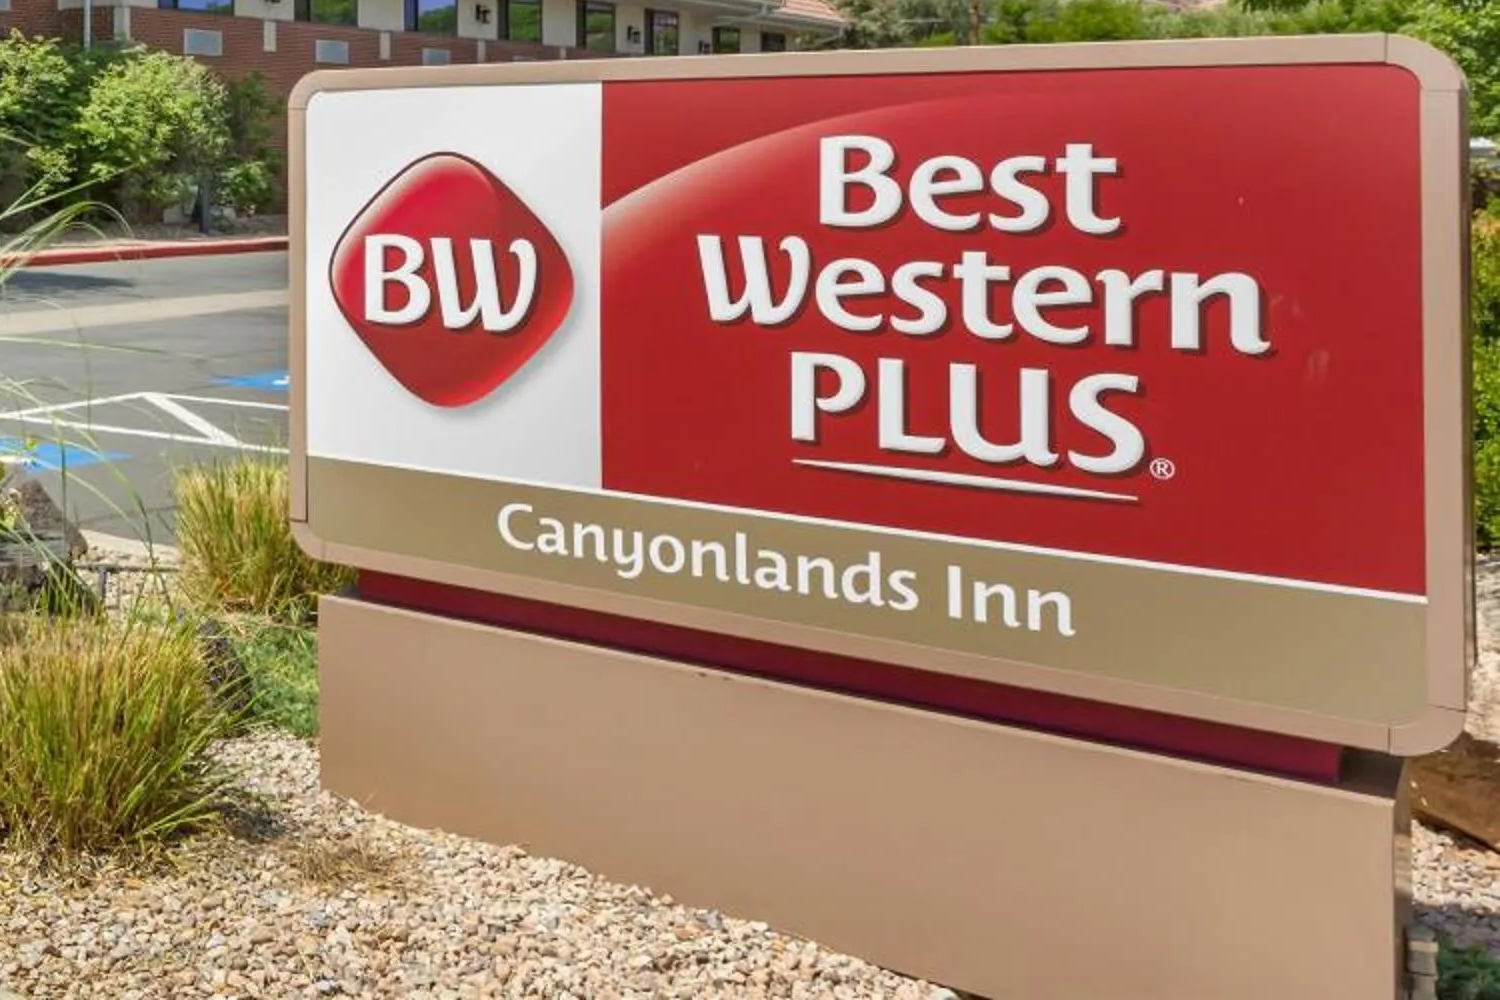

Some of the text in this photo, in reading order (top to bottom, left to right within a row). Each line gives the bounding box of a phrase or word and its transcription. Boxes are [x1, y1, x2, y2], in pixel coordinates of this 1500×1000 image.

[818, 134, 1122, 235] Best
[363, 232, 538, 332] BW
[696, 233, 1272, 355] Western
[790, 350, 1146, 475] PLUS
[496, 502, 1077, 638] Canyonlands Inn
